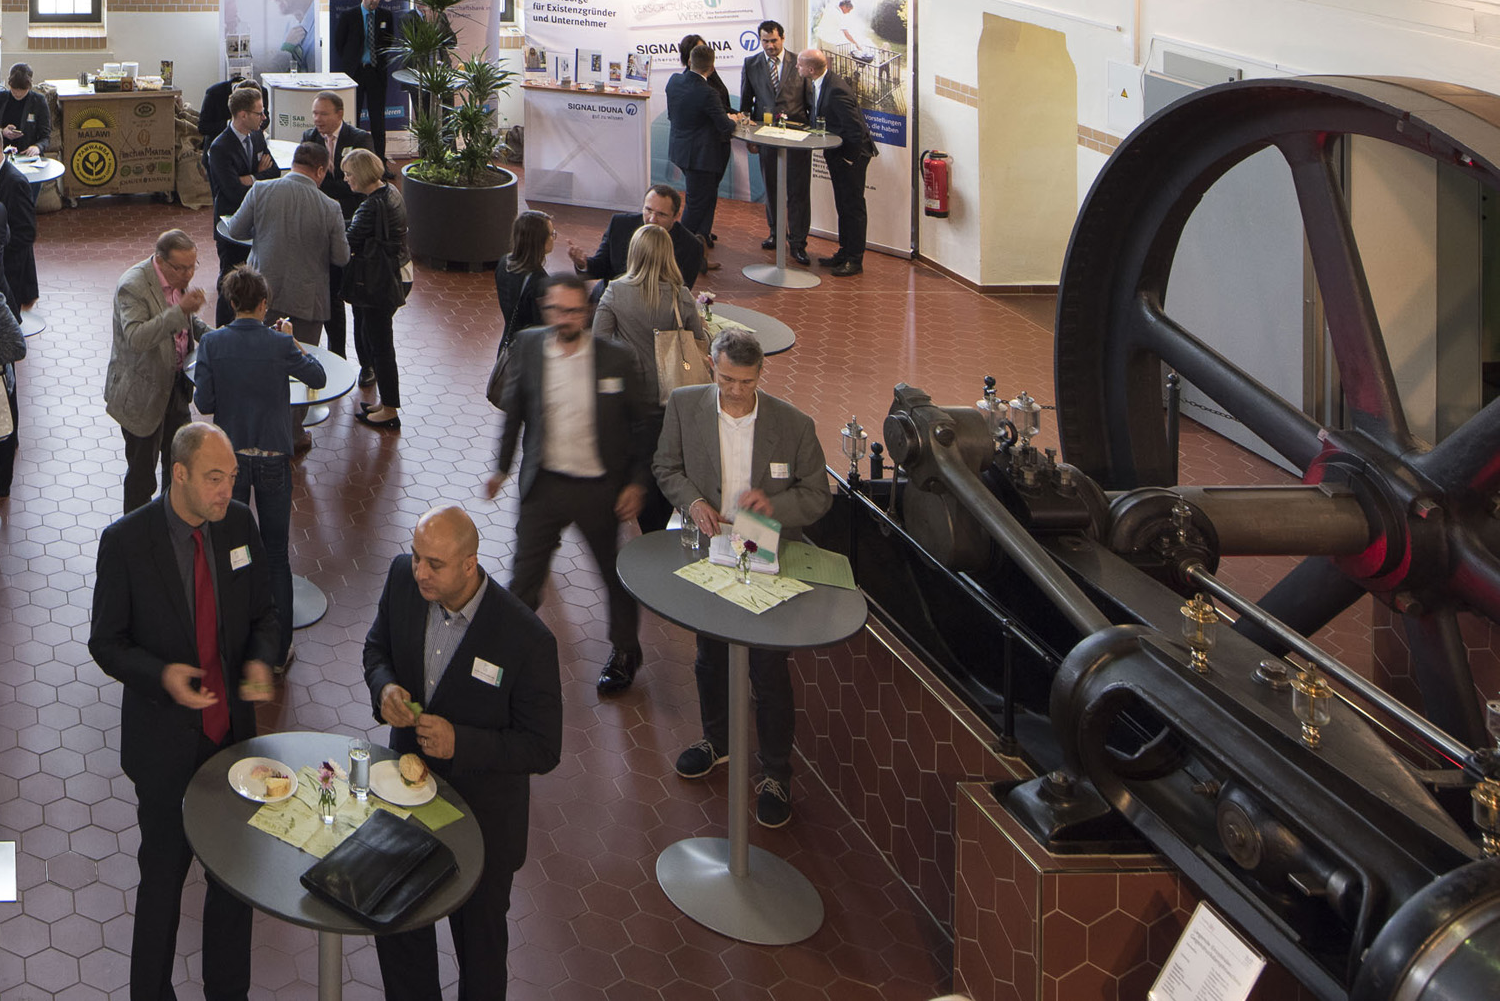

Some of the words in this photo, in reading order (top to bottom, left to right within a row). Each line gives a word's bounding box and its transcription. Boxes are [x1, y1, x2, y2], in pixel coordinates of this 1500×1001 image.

[533, 2, 546, 12] für
[547, 3, 617, 19] Existenzgründer
[677, 11, 706, 22] WERK
[533, 14, 549, 23] und
[551, 15, 608, 28] Unternehmer
[567, 102, 597, 112] SIGNAL
[598, 105, 624, 114] IDUNA
[864, 114, 902, 127] Vorstellungen
[77, 130, 110, 139] MALAWI
[881, 124, 900, 134] haben
